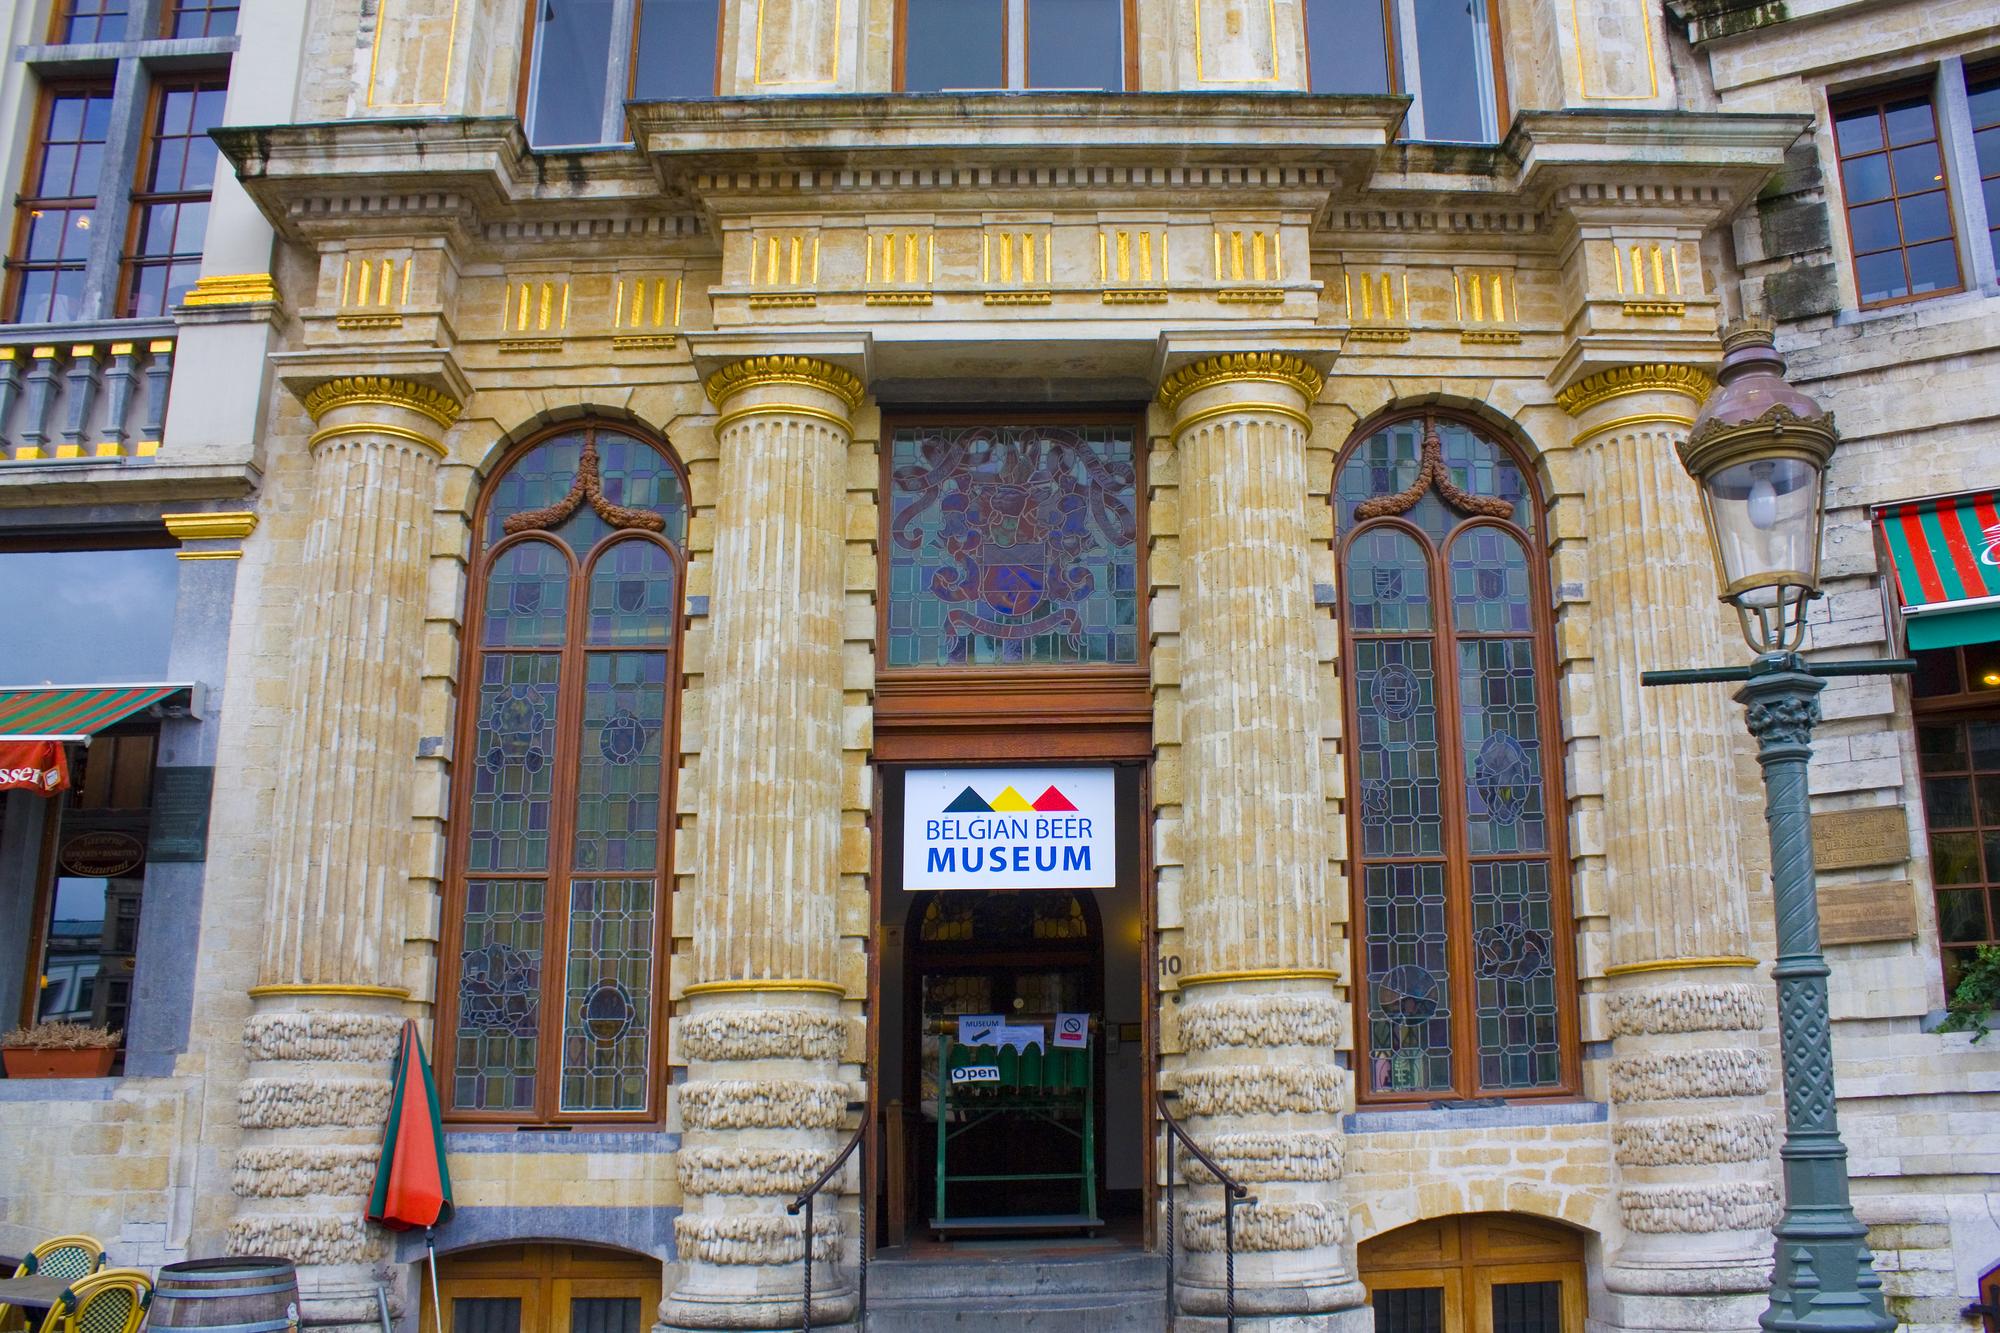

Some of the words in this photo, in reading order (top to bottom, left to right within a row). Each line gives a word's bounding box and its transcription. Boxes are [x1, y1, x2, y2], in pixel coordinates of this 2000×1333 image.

[927, 819, 1028, 840] BELGIAN
[1036, 818, 1093, 839] BEER
[71, 860, 128, 874] Restaurant
[927, 845, 1091, 872] MUSEUM
[1159, 955, 1182, 976] 10
[965, 1020, 999, 1028] MUSEUM
[953, 1067, 998, 1080] Open
